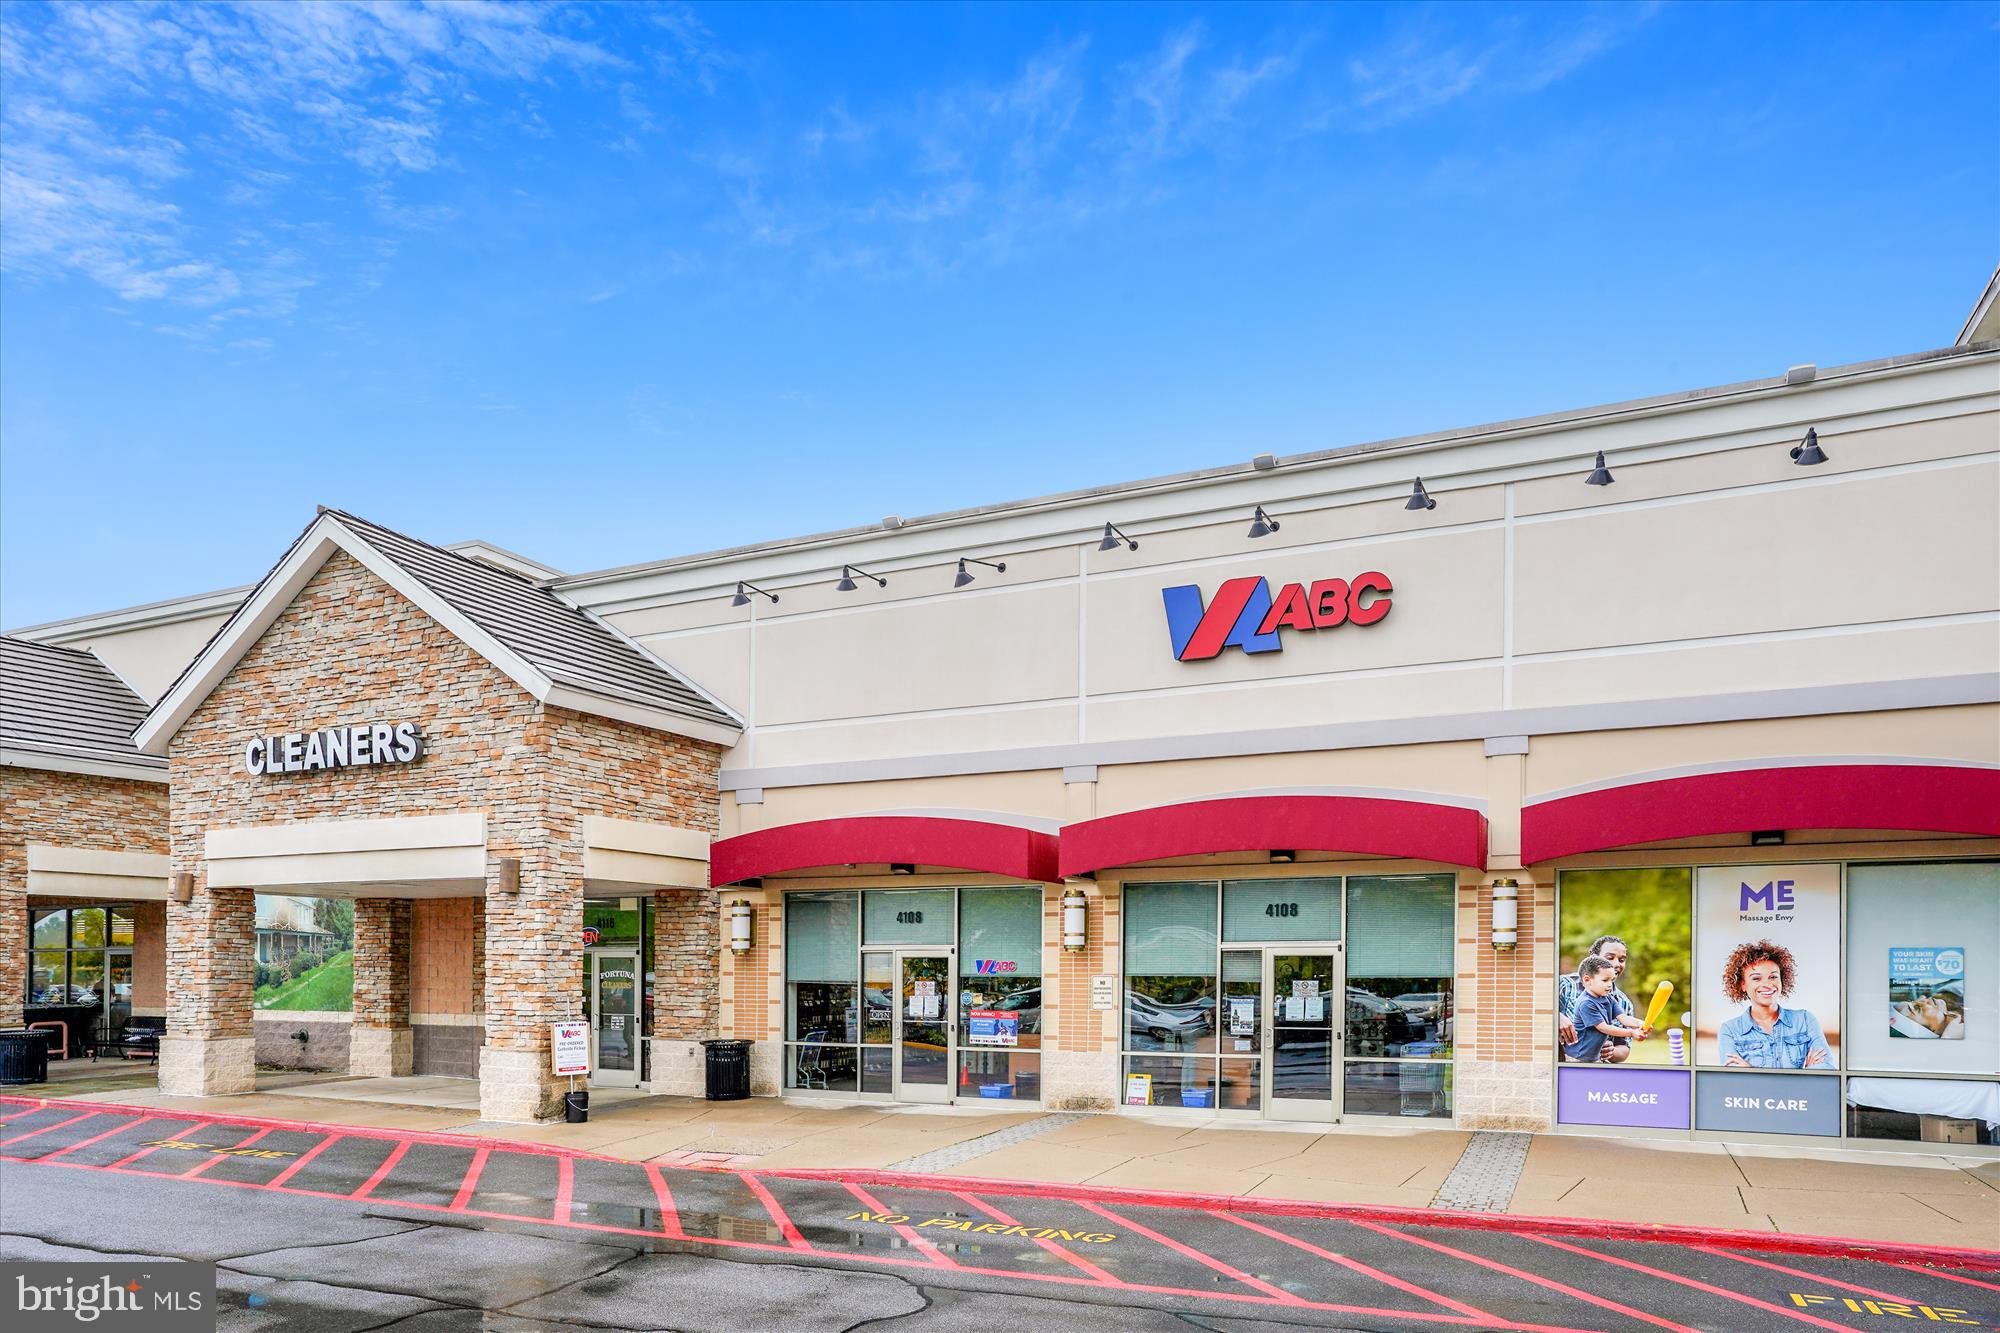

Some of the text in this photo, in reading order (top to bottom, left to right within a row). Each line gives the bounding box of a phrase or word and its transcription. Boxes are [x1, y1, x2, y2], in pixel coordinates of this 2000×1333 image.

[245, 721, 423, 776] CLEANERS
[1740, 880, 1795, 911] ME
[1265, 902, 1298, 917] 4108
[896, 911, 923, 924] 4108
[1740, 914, 1794, 924] Massage Envy
[600, 970, 635, 980] FORTUNA
[601, 981, 634, 989] CLEANERS
[1588, 1091, 1658, 1105] MASSAGE
[1724, 1096, 1808, 1111] SKIN CARE
[844, 1211, 1117, 1243] NO PARKING
[1789, 1293, 1980, 1325] FIRE
